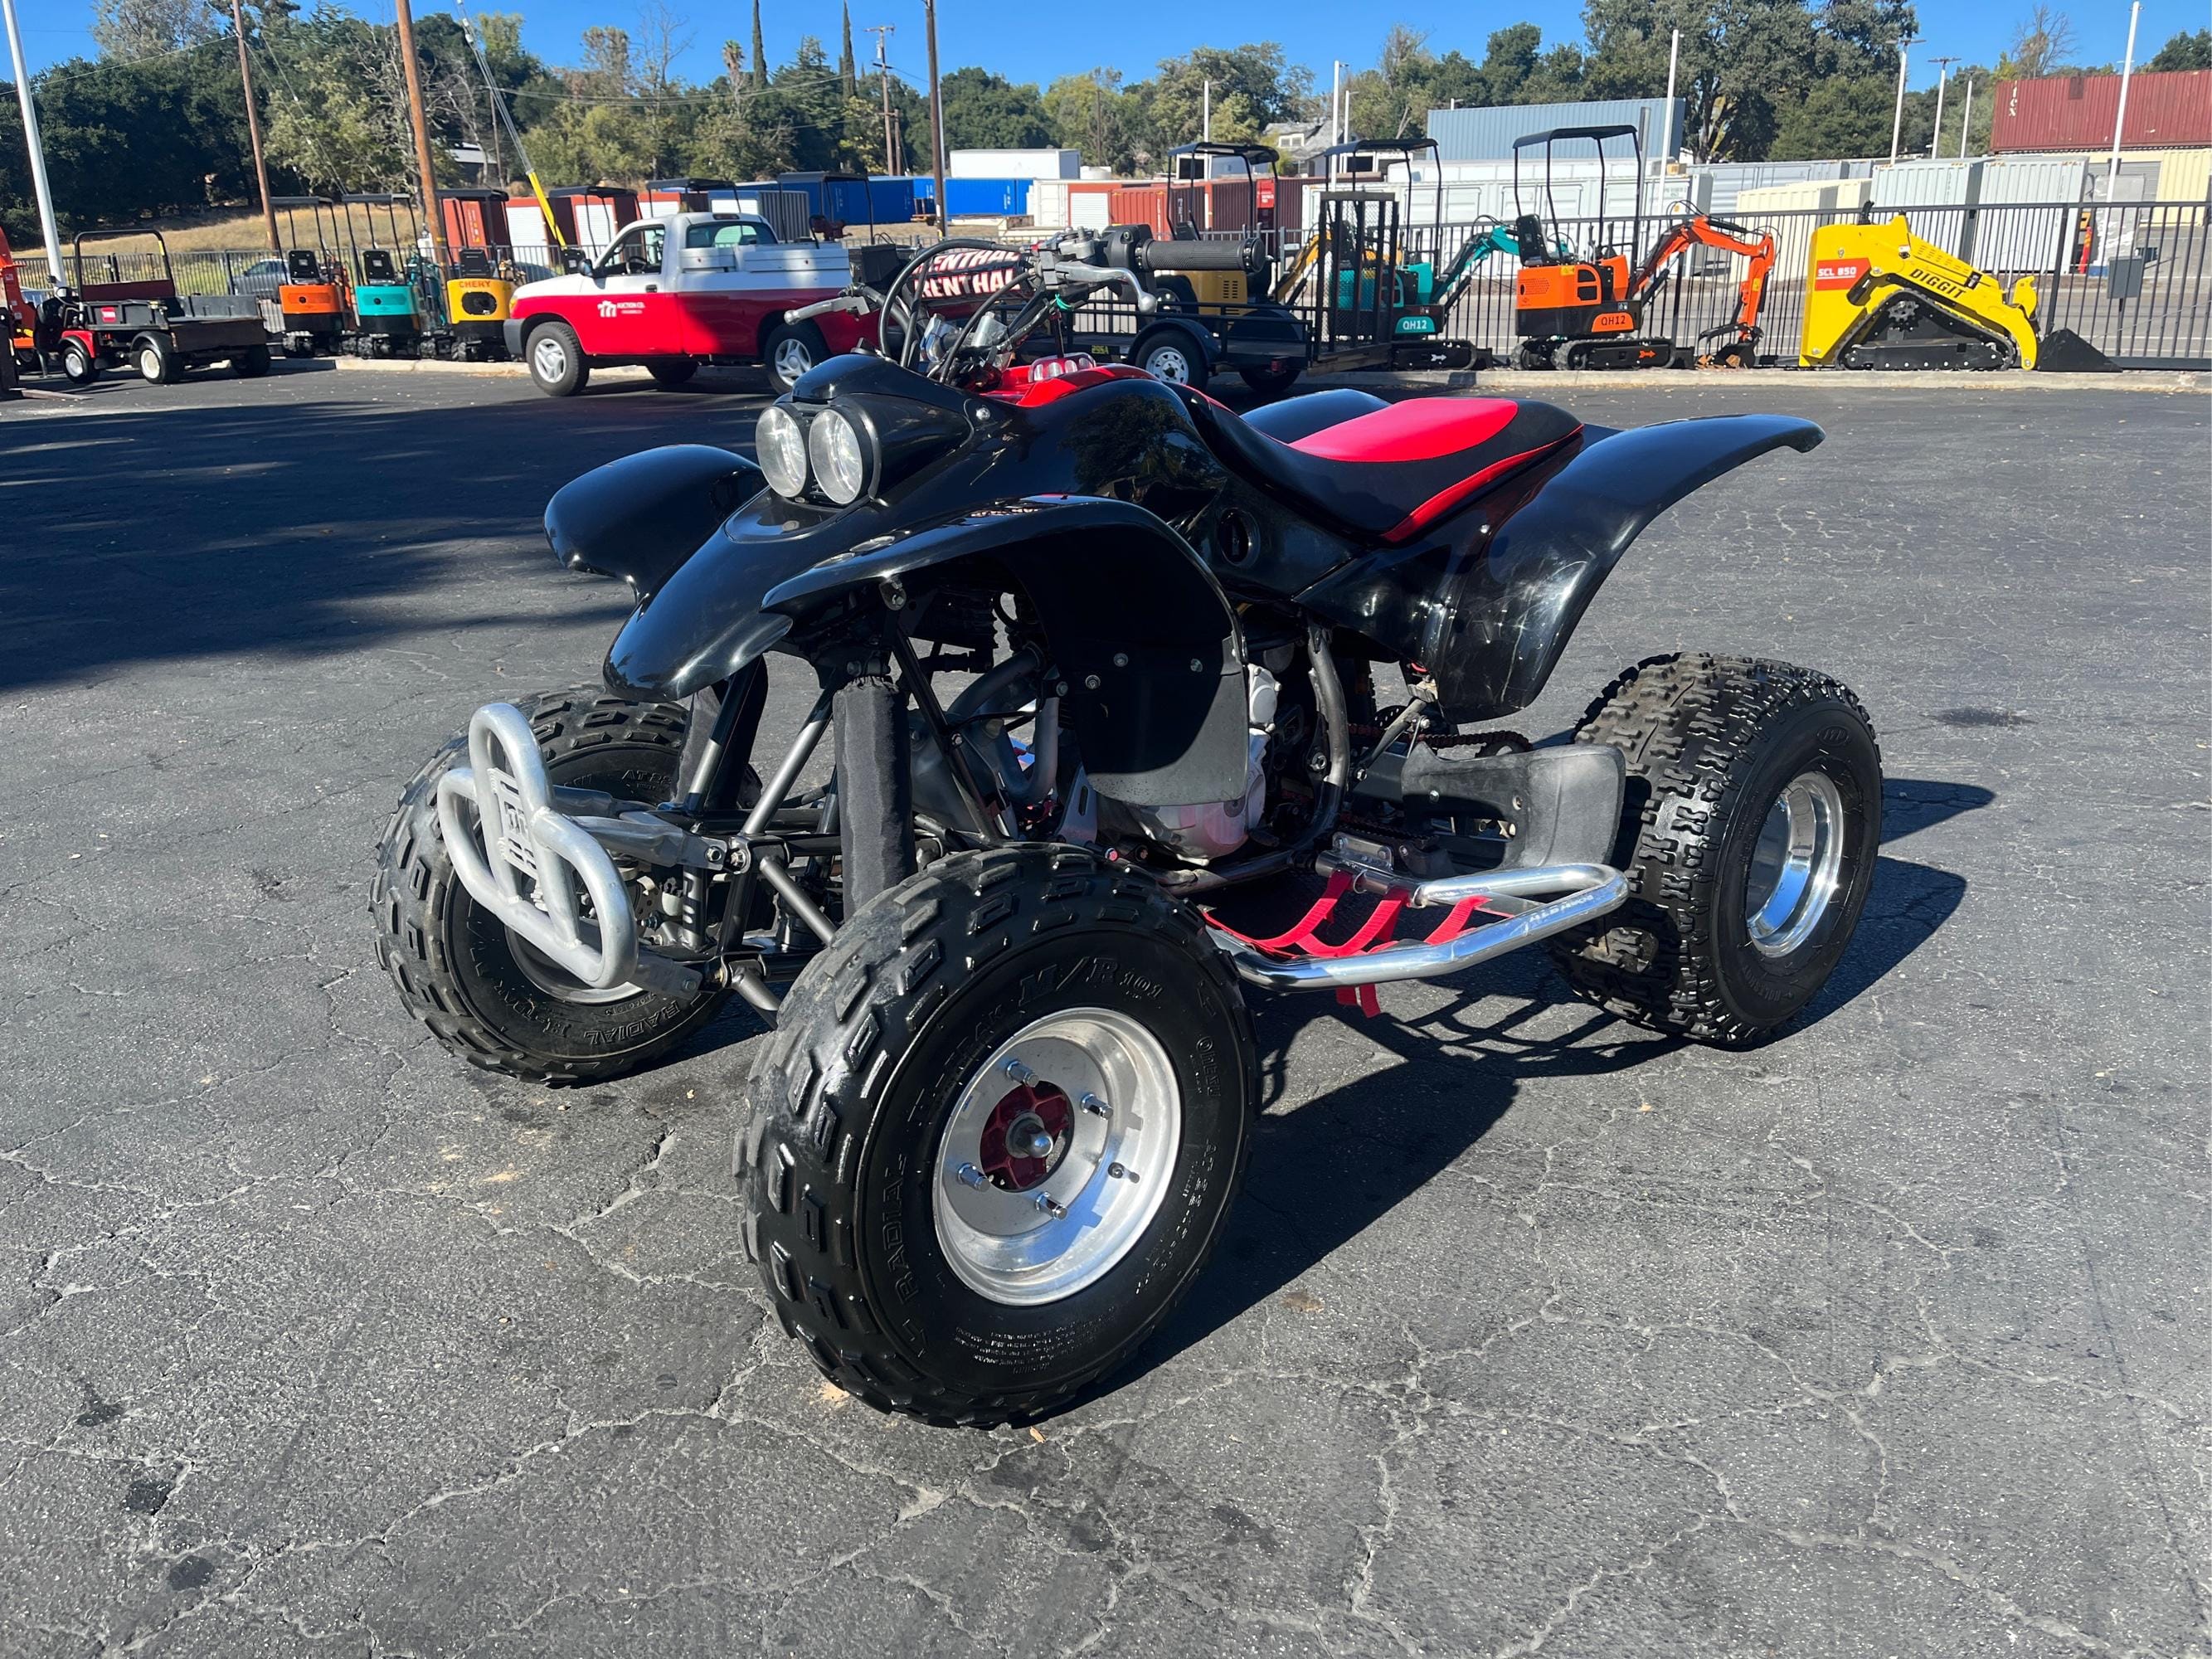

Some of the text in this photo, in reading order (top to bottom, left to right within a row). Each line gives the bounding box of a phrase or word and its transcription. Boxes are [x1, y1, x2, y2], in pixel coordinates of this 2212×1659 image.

[1817, 266, 1857, 277] SCL 850
[1909, 268, 1966, 299] DIGGIT
[1403, 319, 1427, 330] QH12
[1601, 315, 1626, 326] QH12
[1120, 971, 1162, 998] 101
[583, 1000, 681, 1045] RADIAL
[882, 1153, 920, 1306] RADIAL
